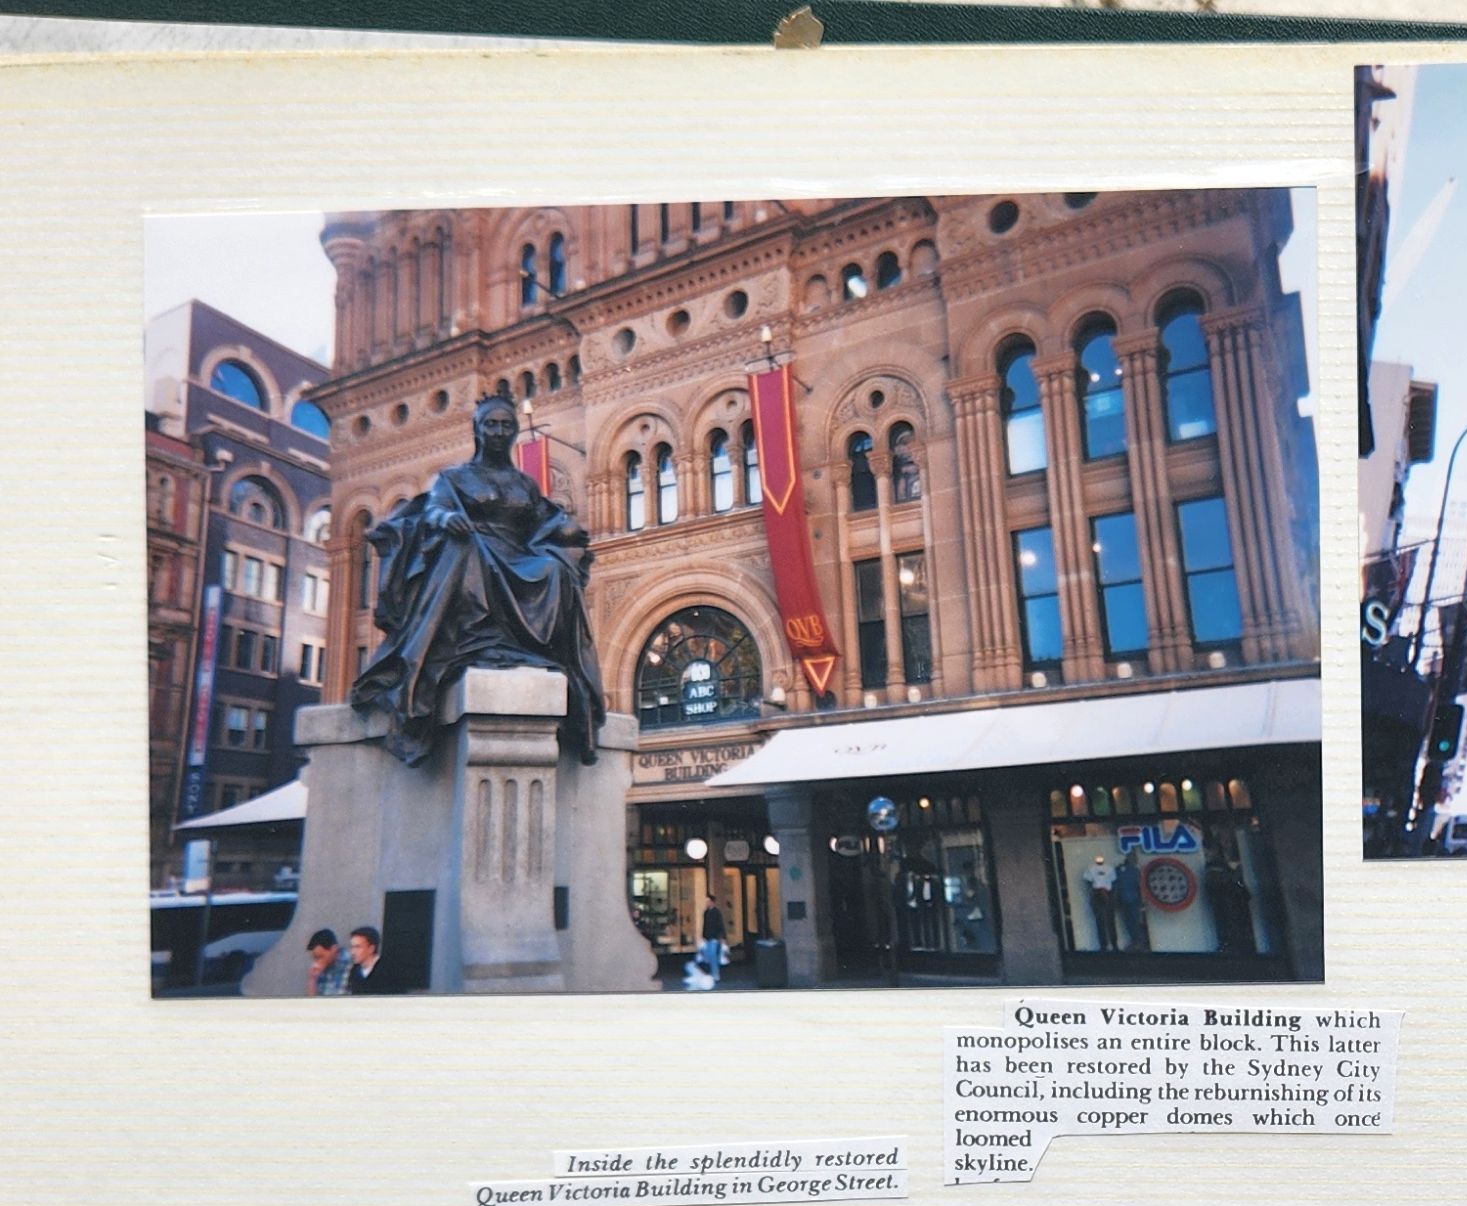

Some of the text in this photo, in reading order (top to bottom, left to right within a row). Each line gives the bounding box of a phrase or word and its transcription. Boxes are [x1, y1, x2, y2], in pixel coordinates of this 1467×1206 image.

[689, 685, 715, 699] ABC
[685, 702, 717, 715] SHOP
[638, 744, 755, 769] QUEEN VICTORIA
[1117, 825, 1199, 853] FILA
[1015, 1006, 1380, 1031] Queen Victoria Building which
[957, 1031, 1377, 1053] monopolises an entire block. This latter
[957, 1055, 1377, 1081] has been restored by the Sydney City
[956, 1079, 1380, 1105] Council, including the reburnishing of its
[955, 1106, 1380, 1128] enormous copper domes which once
[956, 1128, 1031, 1146] loomed
[568, 1147, 897, 1174] Inside the splendidly restored
[955, 1152, 1032, 1171] skyline.
[550, 1184, 629, 1200] Victoria
[636, 1178, 727, 1199] Building
[733, 1176, 751, 1193] in
[758, 1175, 831, 1196] George
[835, 1173, 897, 1190] Street.
